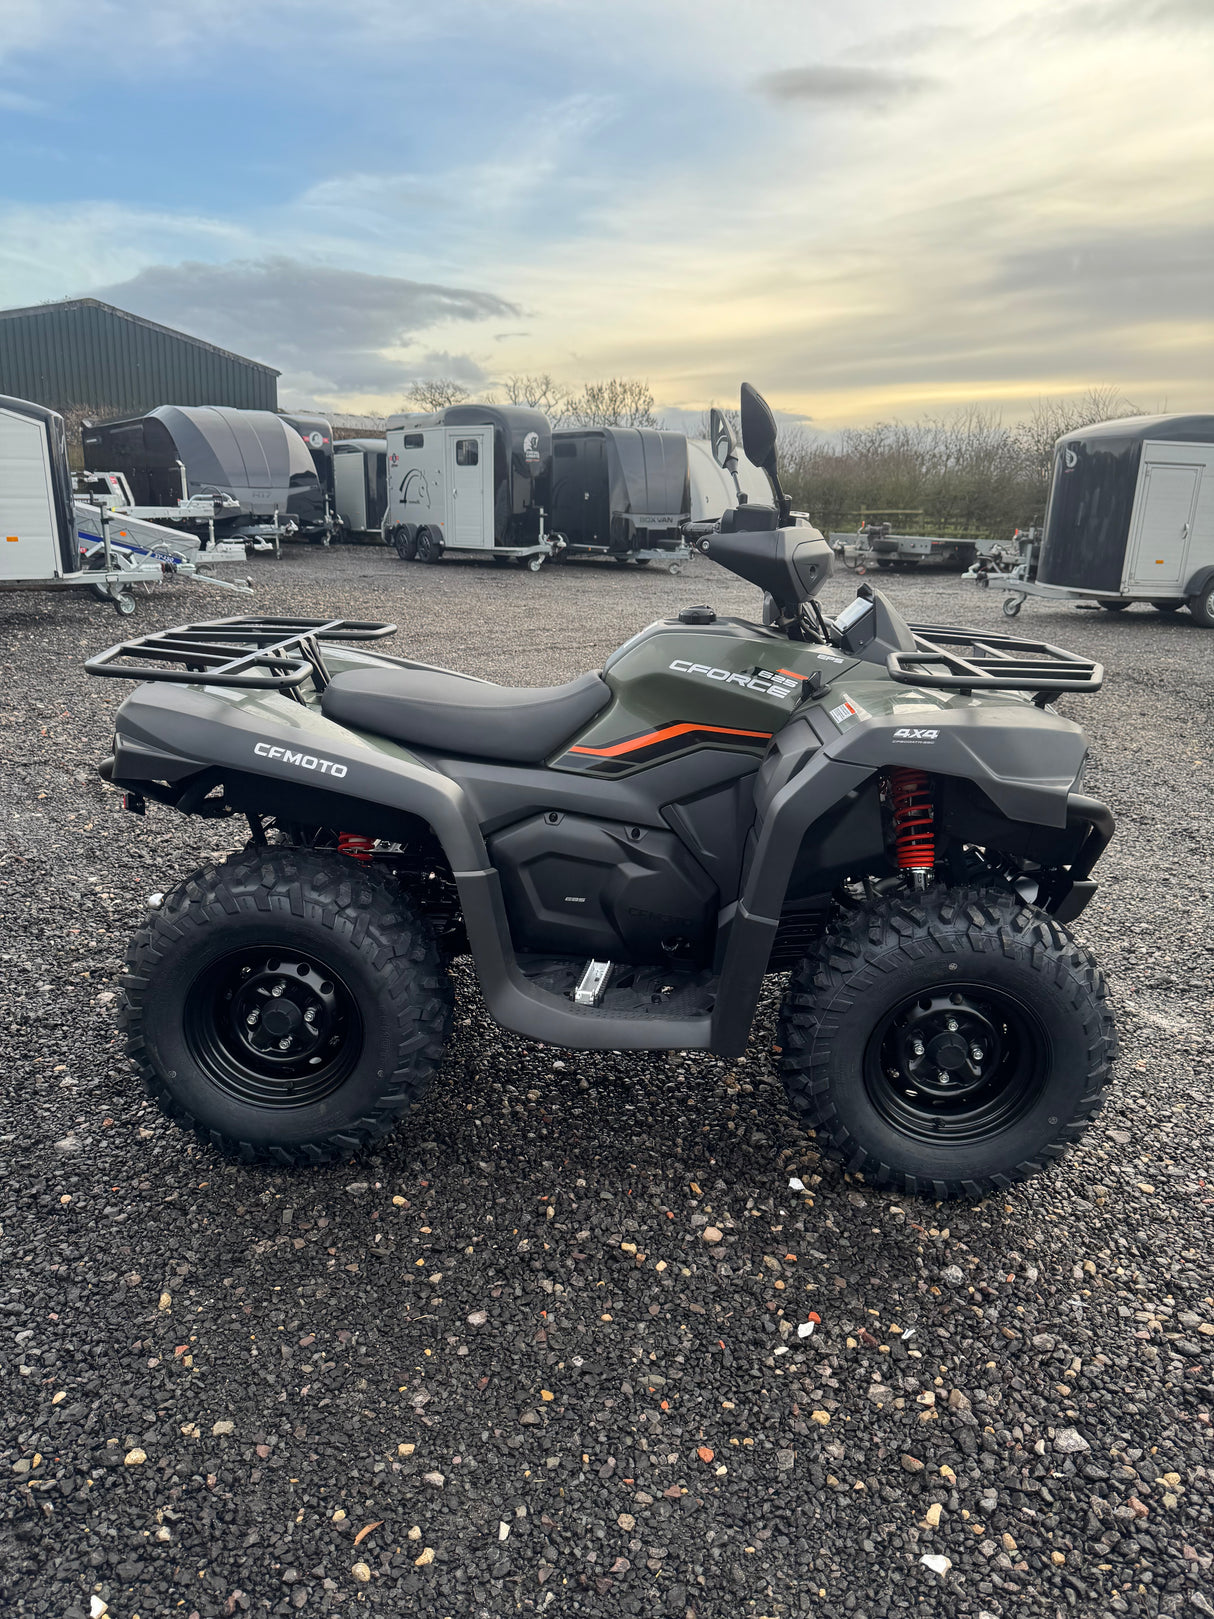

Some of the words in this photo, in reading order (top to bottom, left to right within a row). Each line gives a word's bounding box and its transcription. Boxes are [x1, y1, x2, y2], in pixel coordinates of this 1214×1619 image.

[816, 654, 845, 664] EPS
[669, 659, 792, 699] CFORCE
[756, 669, 800, 688] 625
[254, 743, 348, 778] CFMOTO
